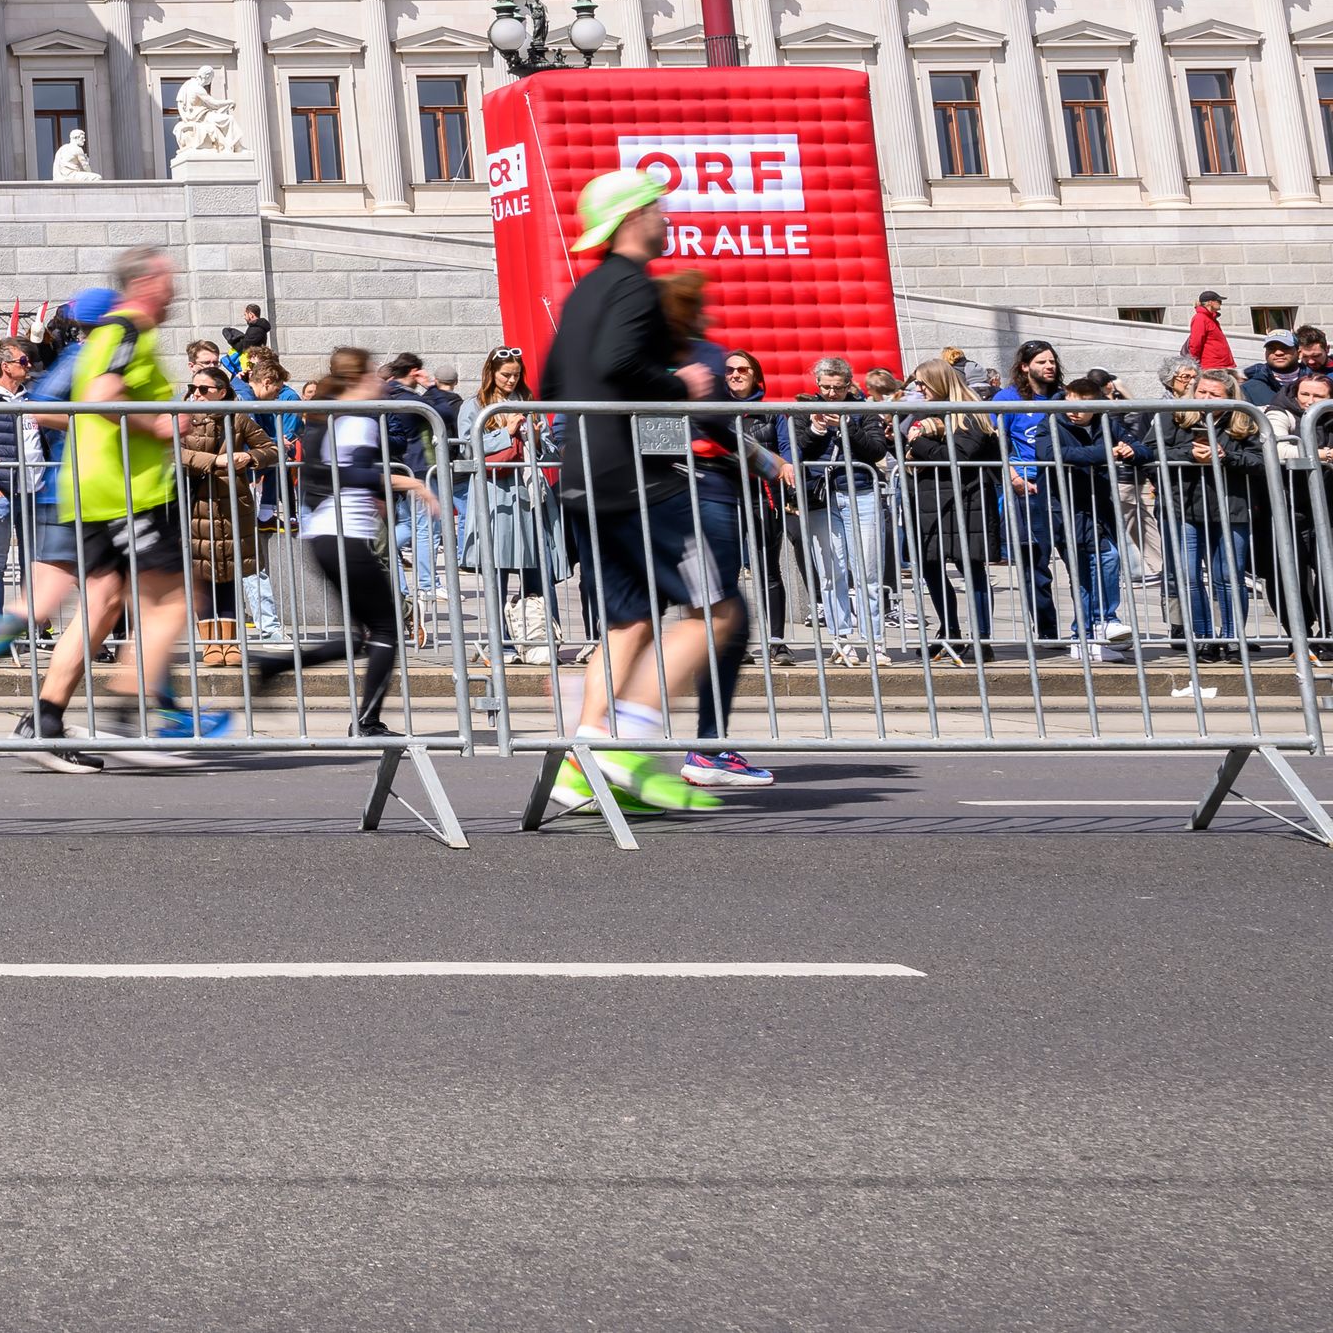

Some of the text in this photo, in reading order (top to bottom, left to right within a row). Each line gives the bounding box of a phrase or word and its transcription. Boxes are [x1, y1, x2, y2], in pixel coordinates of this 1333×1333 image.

[636, 151, 787, 195] ORF
[661, 217, 810, 256] ÜR ALLE
